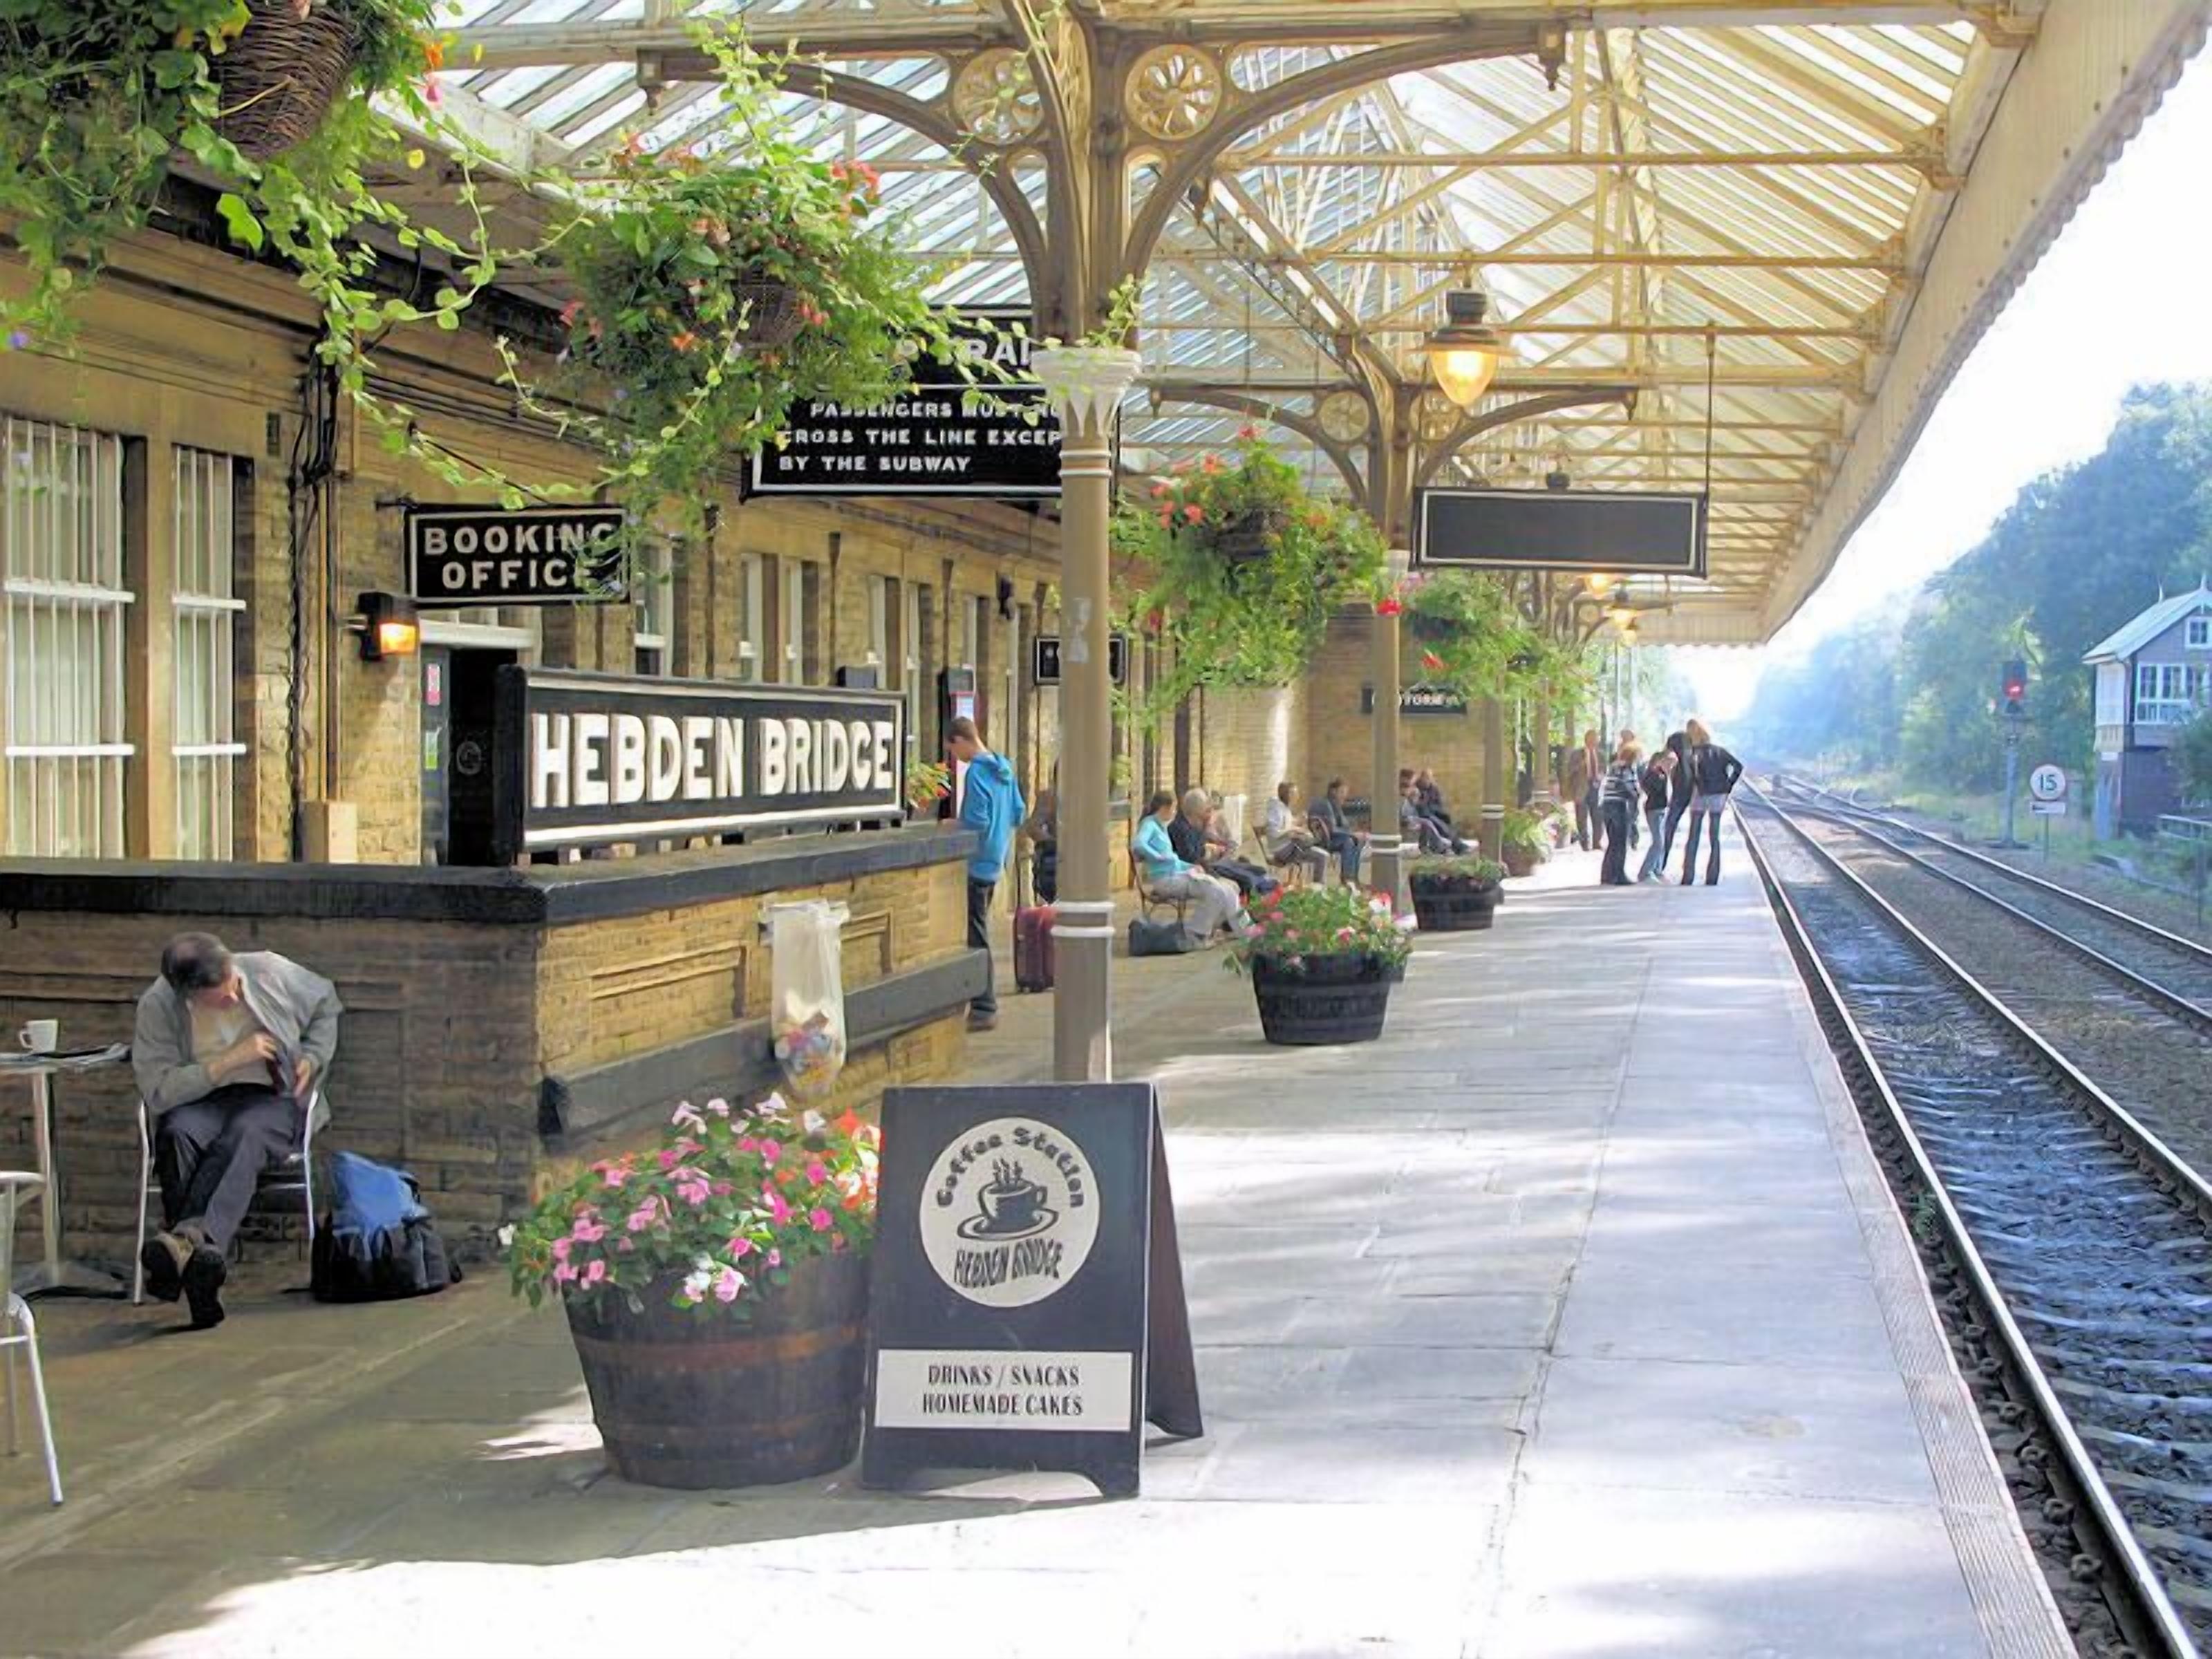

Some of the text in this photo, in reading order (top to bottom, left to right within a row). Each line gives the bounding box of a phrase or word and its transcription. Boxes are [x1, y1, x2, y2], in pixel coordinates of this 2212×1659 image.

[780, 429, 1061, 445] ROSS THE LINE EXCEP
[779, 455, 971, 472] BY THE SUBWAY
[530, 712, 894, 809] HEBDEN BRIDGE
[2040, 774, 2057, 791] 15
[937, 1126, 1084, 1208] Coffee Station
[928, 1365, 993, 1386] DRINKS
[1011, 1365, 1080, 1386] SNACKS
[922, 1393, 1084, 1416] HOMEMADE CAKES
